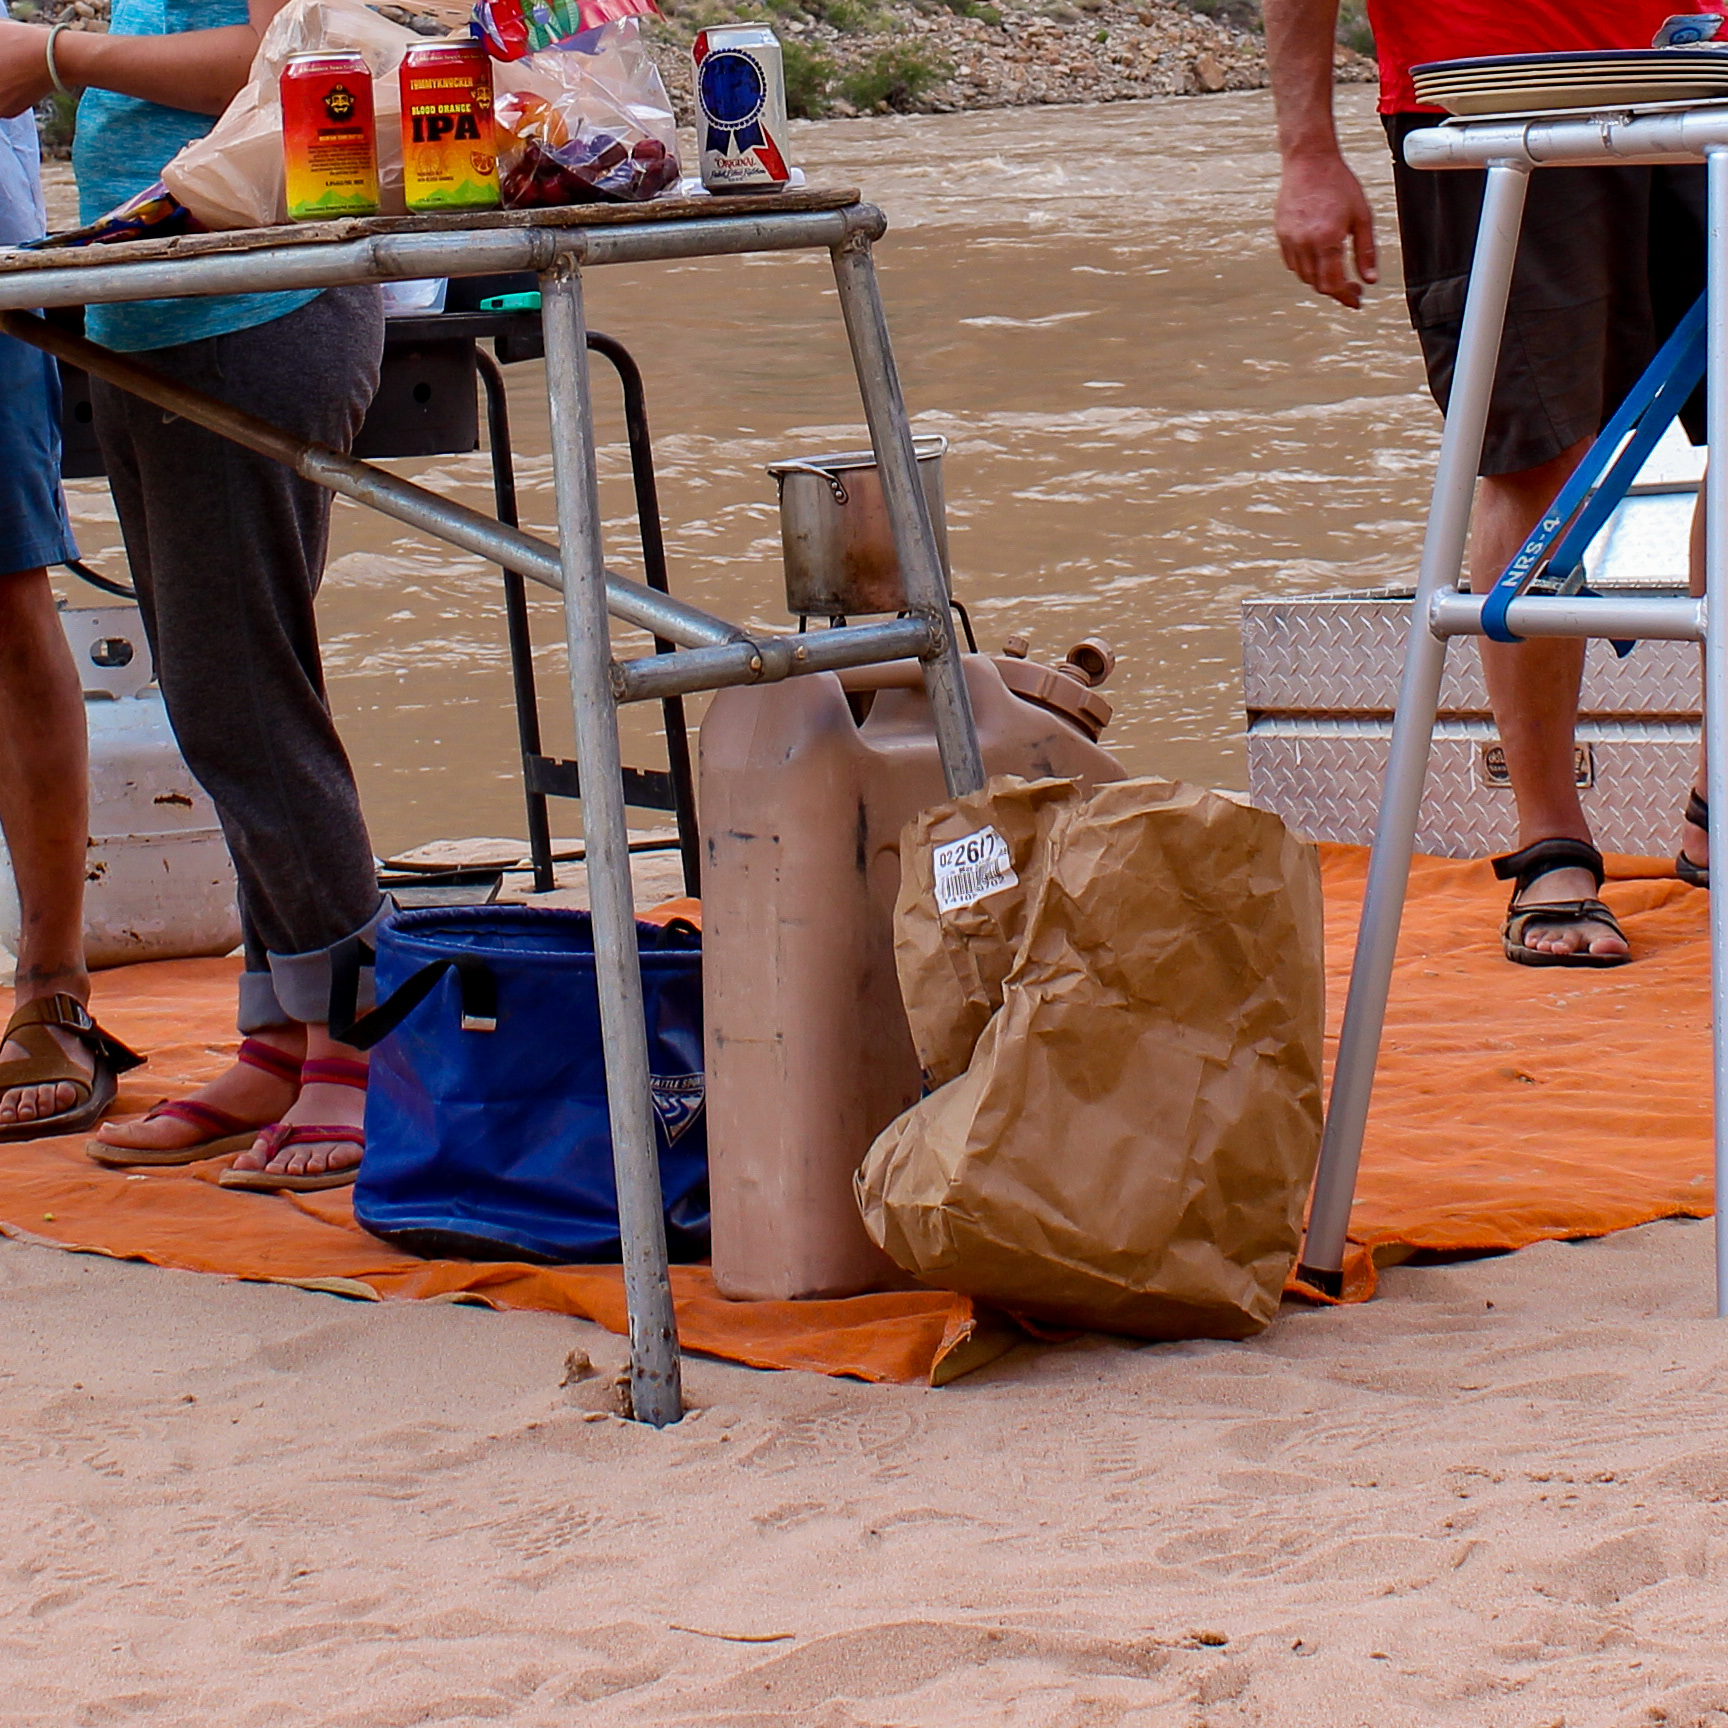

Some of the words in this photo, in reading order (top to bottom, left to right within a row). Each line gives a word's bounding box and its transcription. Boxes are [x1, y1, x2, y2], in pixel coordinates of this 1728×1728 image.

[410, 75, 474, 91] TOMMYKNOCKER
[411, 105, 436, 116] BLOOD
[437, 103, 472, 115] ORANGE
[412, 113, 482, 143] IPA
[1500, 516, 1560, 587] NRS-4
[939, 850, 953, 868] 02
[953, 833, 995, 868] 2617
